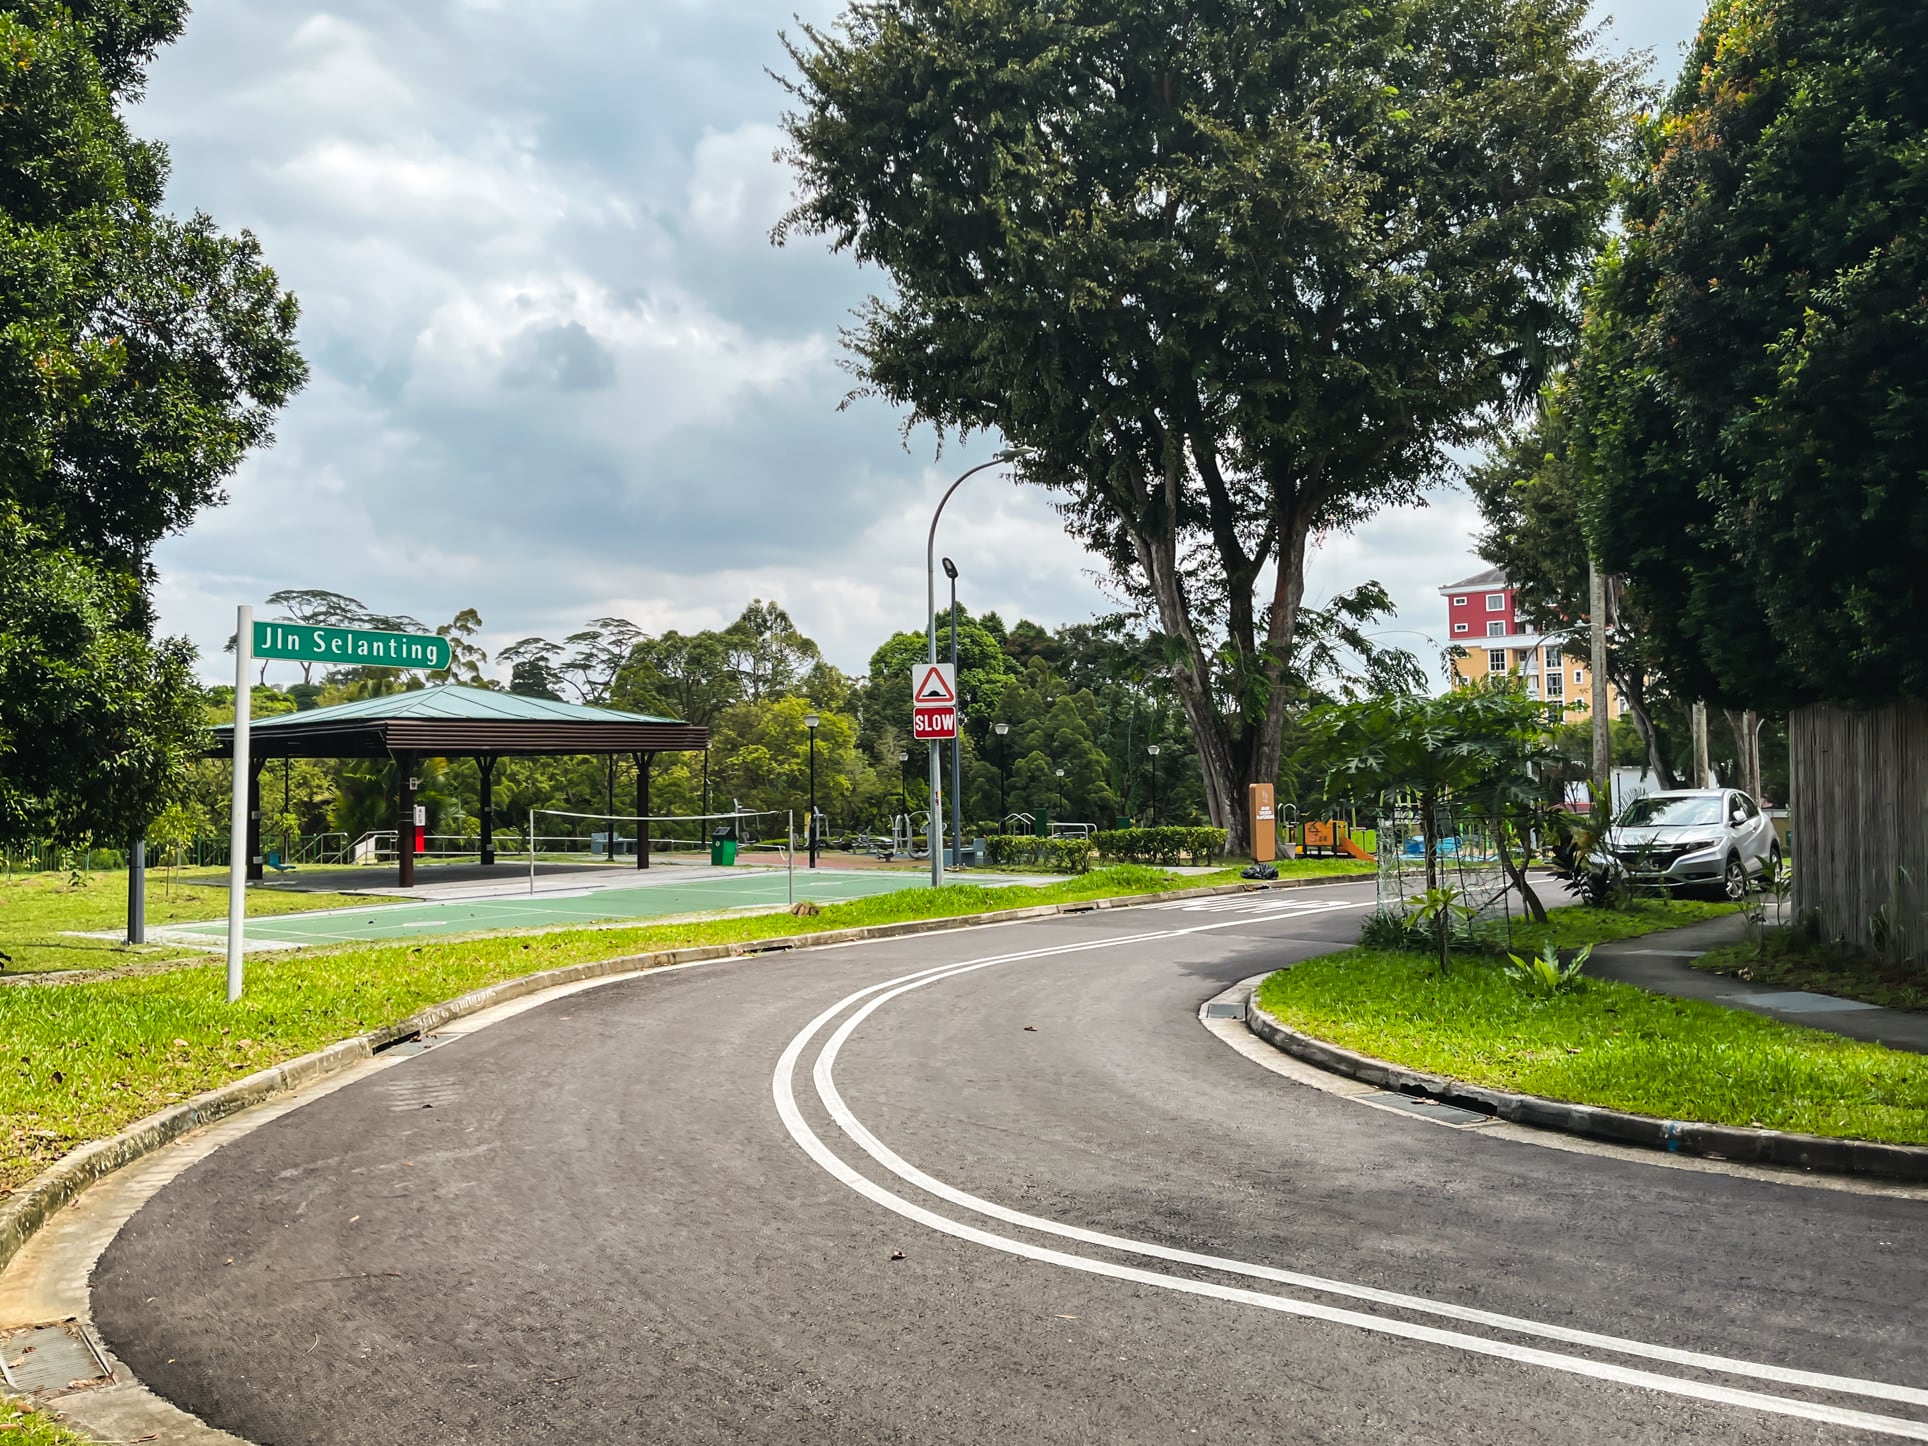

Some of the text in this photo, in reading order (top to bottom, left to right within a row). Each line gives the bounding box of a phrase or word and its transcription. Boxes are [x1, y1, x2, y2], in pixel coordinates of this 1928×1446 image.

[261, 627, 438, 665] Jln Selanting
[915, 714, 954, 731] SLOW
